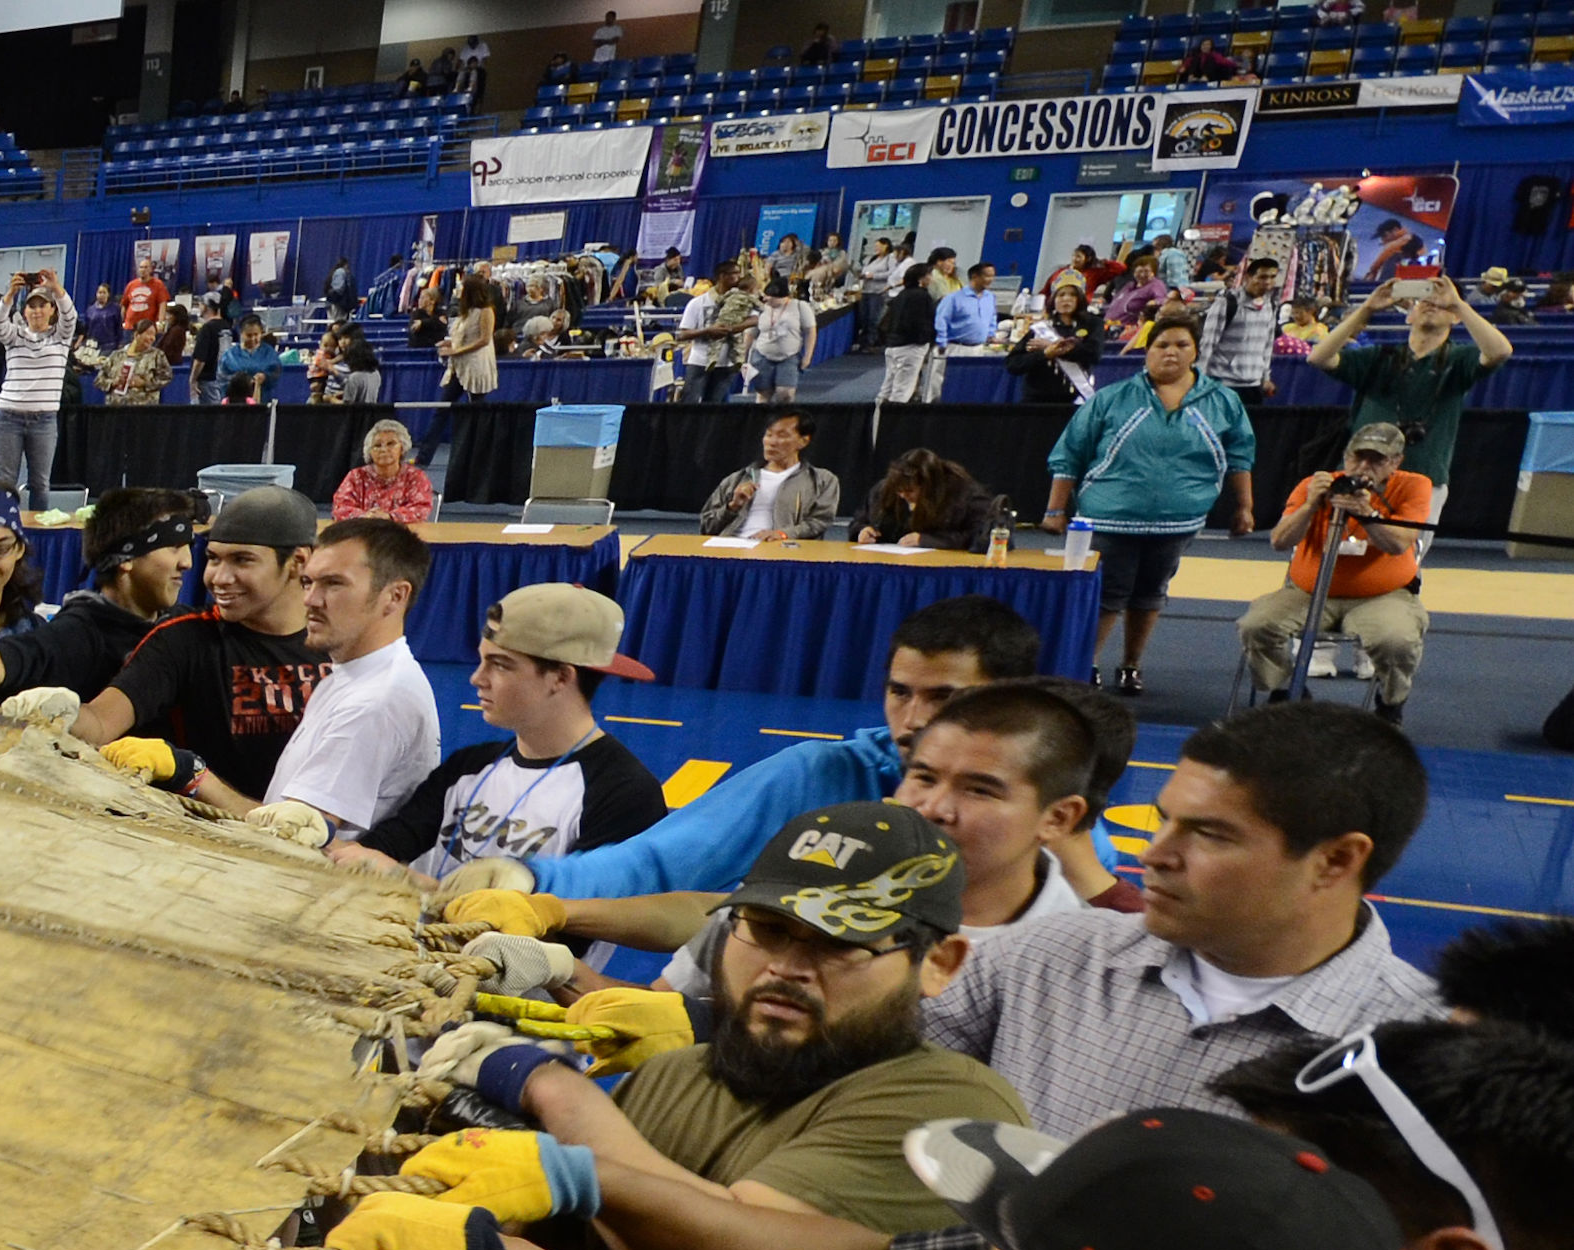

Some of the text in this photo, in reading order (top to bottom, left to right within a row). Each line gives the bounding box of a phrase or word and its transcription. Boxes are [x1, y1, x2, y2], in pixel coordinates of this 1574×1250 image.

[1269, 87, 1352, 105] KINROSS
[1371, 84, 1449, 98] Fort Knox
[936, 95, 1156, 156] CONCESSIONS
[866, 142, 916, 163] GCI
[544, 171, 585, 183] regional
[1412, 200, 1441, 212] GCI
[232, 681, 312, 715] 201
[788, 829, 867, 870] CAT
